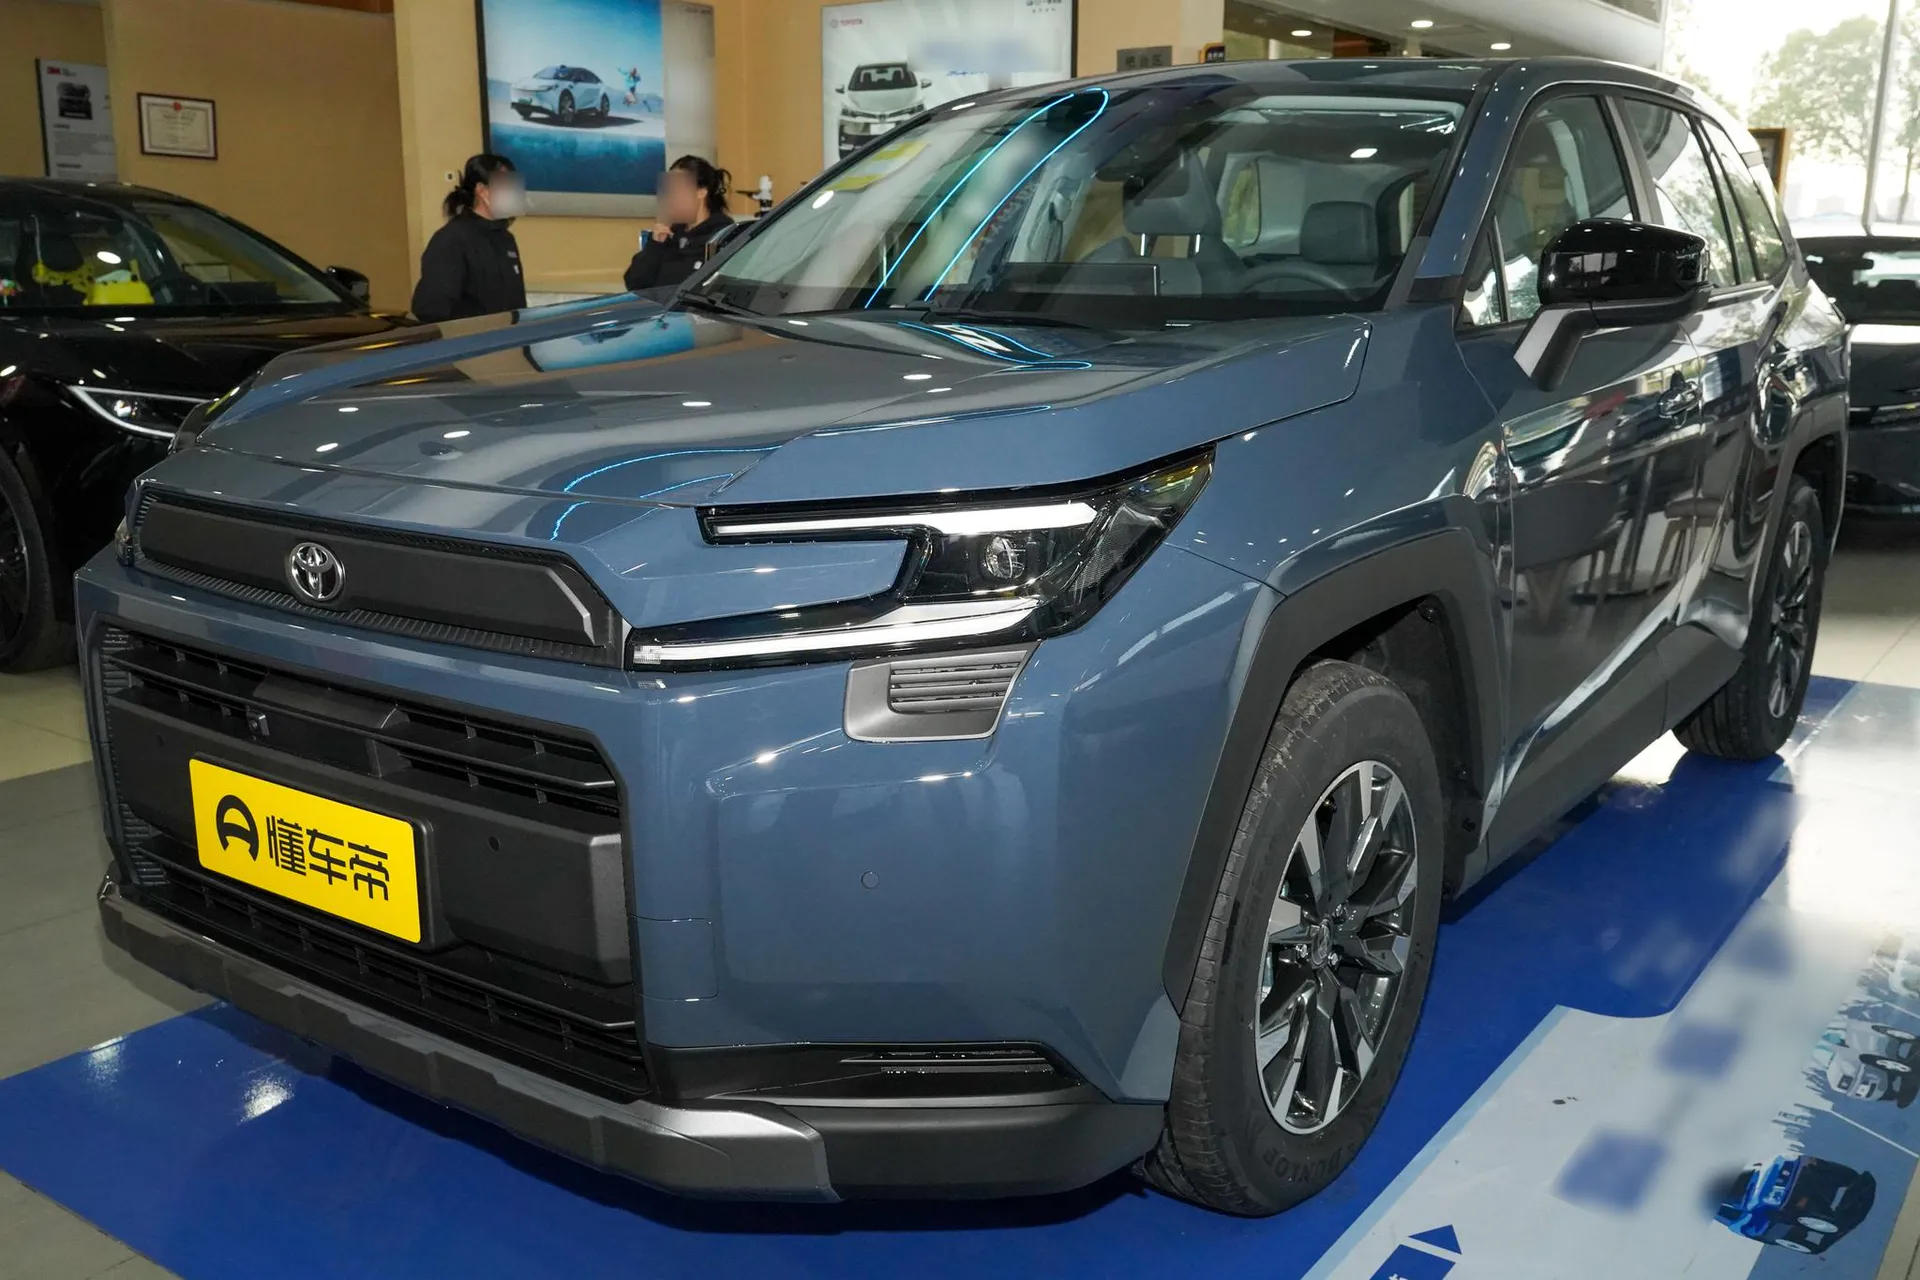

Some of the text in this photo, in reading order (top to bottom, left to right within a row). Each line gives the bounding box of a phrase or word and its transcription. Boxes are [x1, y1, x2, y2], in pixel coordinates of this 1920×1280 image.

[266, 814, 390, 901] 懂车帝
[1262, 1146, 1343, 1183] DUNLOP
